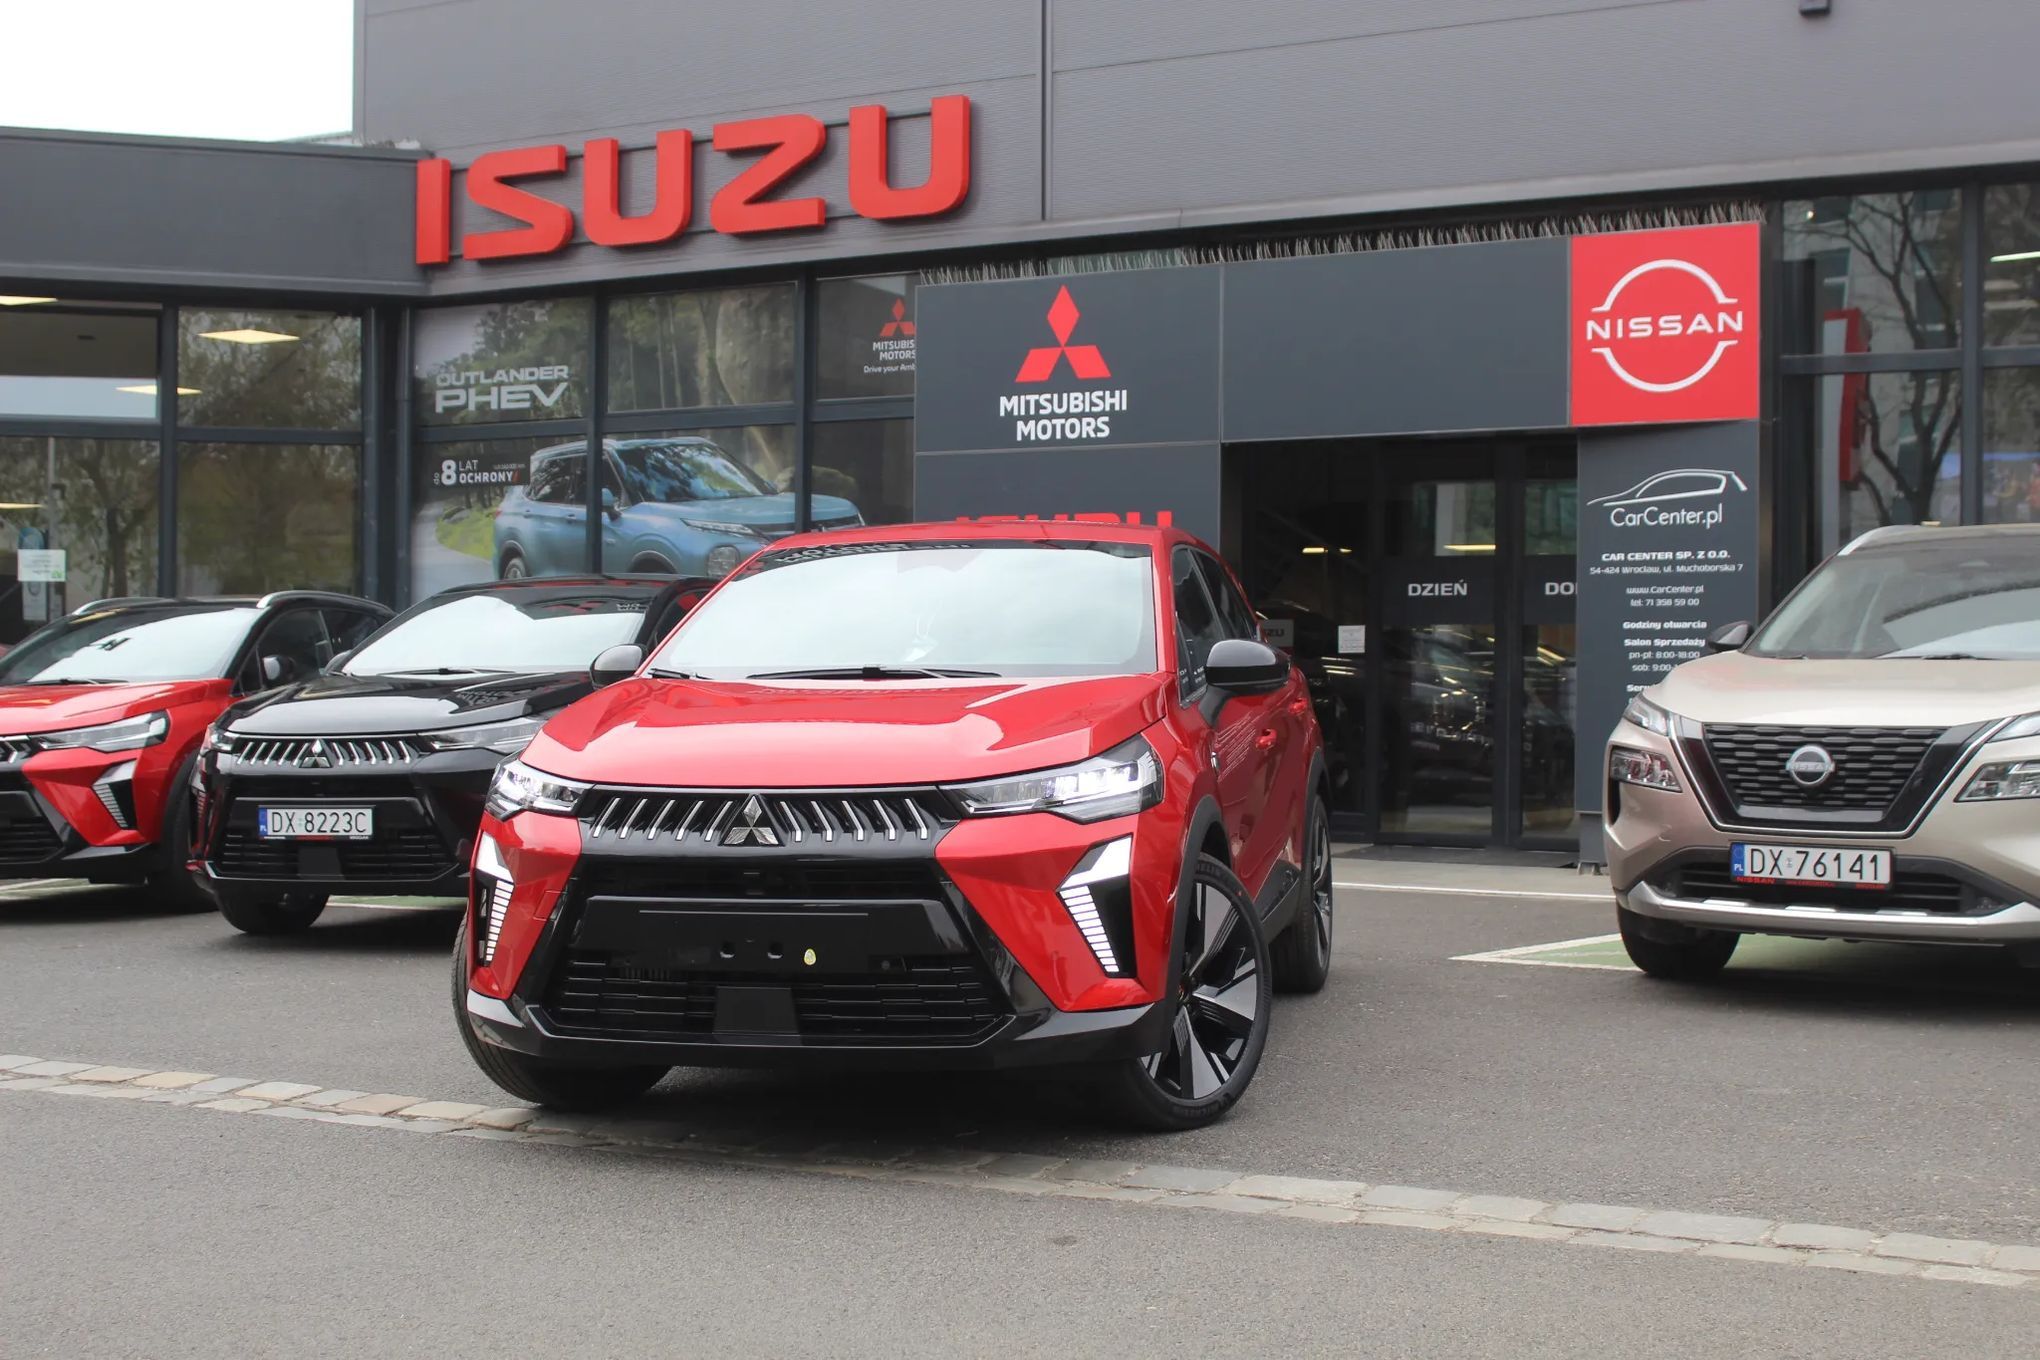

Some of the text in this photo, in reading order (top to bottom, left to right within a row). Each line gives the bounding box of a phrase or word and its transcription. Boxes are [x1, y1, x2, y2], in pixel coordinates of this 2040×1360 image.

[416, 94, 970, 264] ISUZU
[1586, 311, 1743, 340] NISSAN
[872, 339, 915, 351] MITSUBIS
[879, 350, 916, 361] MOTORS
[436, 365, 569, 387] OUTLANDER
[863, 365, 882, 373] Drive
[883, 364, 899, 374] your
[435, 382, 568, 413] PHEV
[999, 389, 1128, 417] MITSUBISHI
[1016, 416, 1111, 441] MOTORS
[441, 459, 457, 486] 8
[458, 459, 479, 471] LAT
[459, 471, 513, 484] OCHRONY
[1610, 503, 1722, 529] CarCenter.pl
[1601, 553, 1625, 562] CAR
[1627, 551, 1673, 561] CENTER
[1675, 551, 1695, 560] SP.
[1737, 563, 1744, 571] 7
[1407, 579, 1468, 596] DZIEŃ
[1545, 582, 1578, 595] DO
[1674, 598, 1686, 606] 59
[1687, 598, 1700, 606] 00
[1623, 621, 1707, 630] Godziny otwarcia
[1624, 638, 1652, 646] Salon
[271, 811, 296, 833] DX
[304, 811, 367, 833] 8223C
[1734, 848, 1878, 881] PL DX 76141
